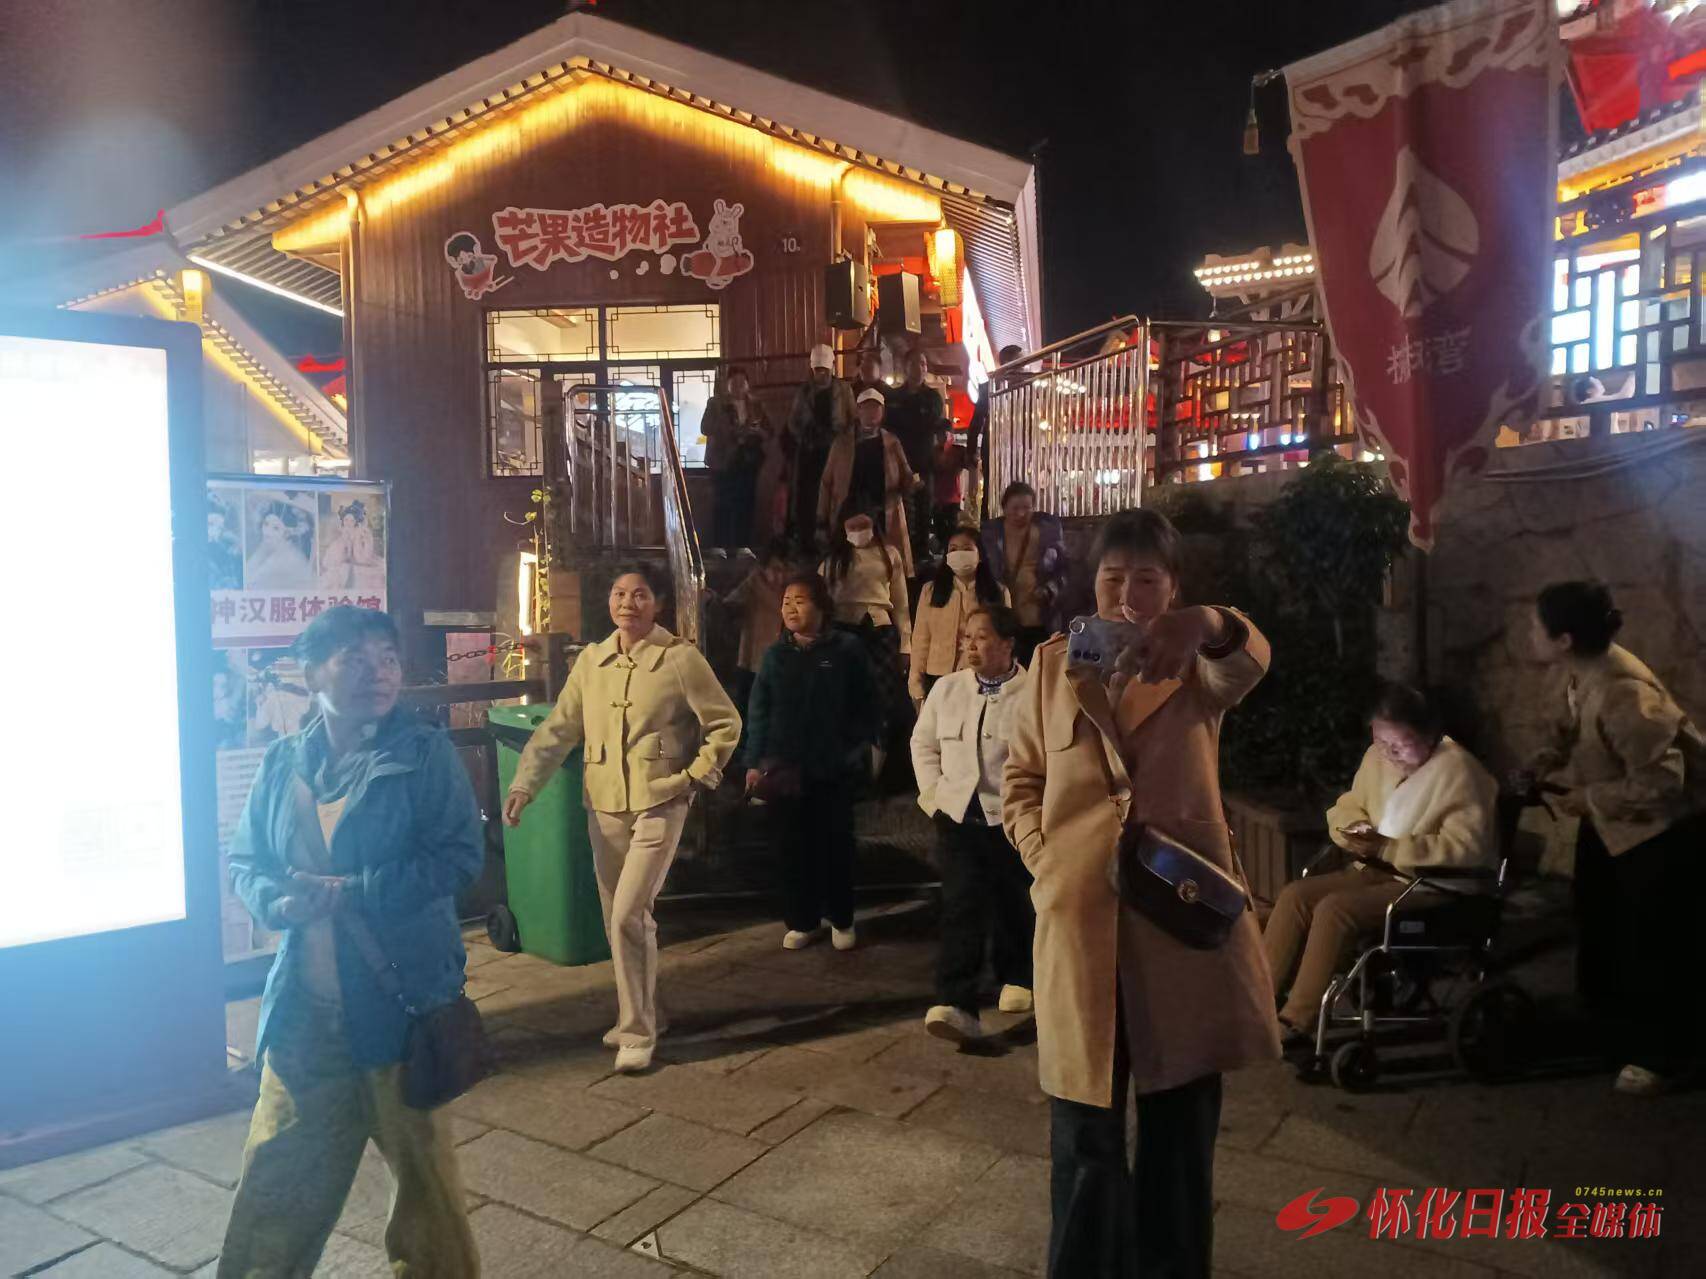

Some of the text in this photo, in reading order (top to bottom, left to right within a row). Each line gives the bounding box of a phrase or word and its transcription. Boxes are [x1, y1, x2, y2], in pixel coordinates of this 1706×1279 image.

[495, 202, 697, 269] 芒果造物社
